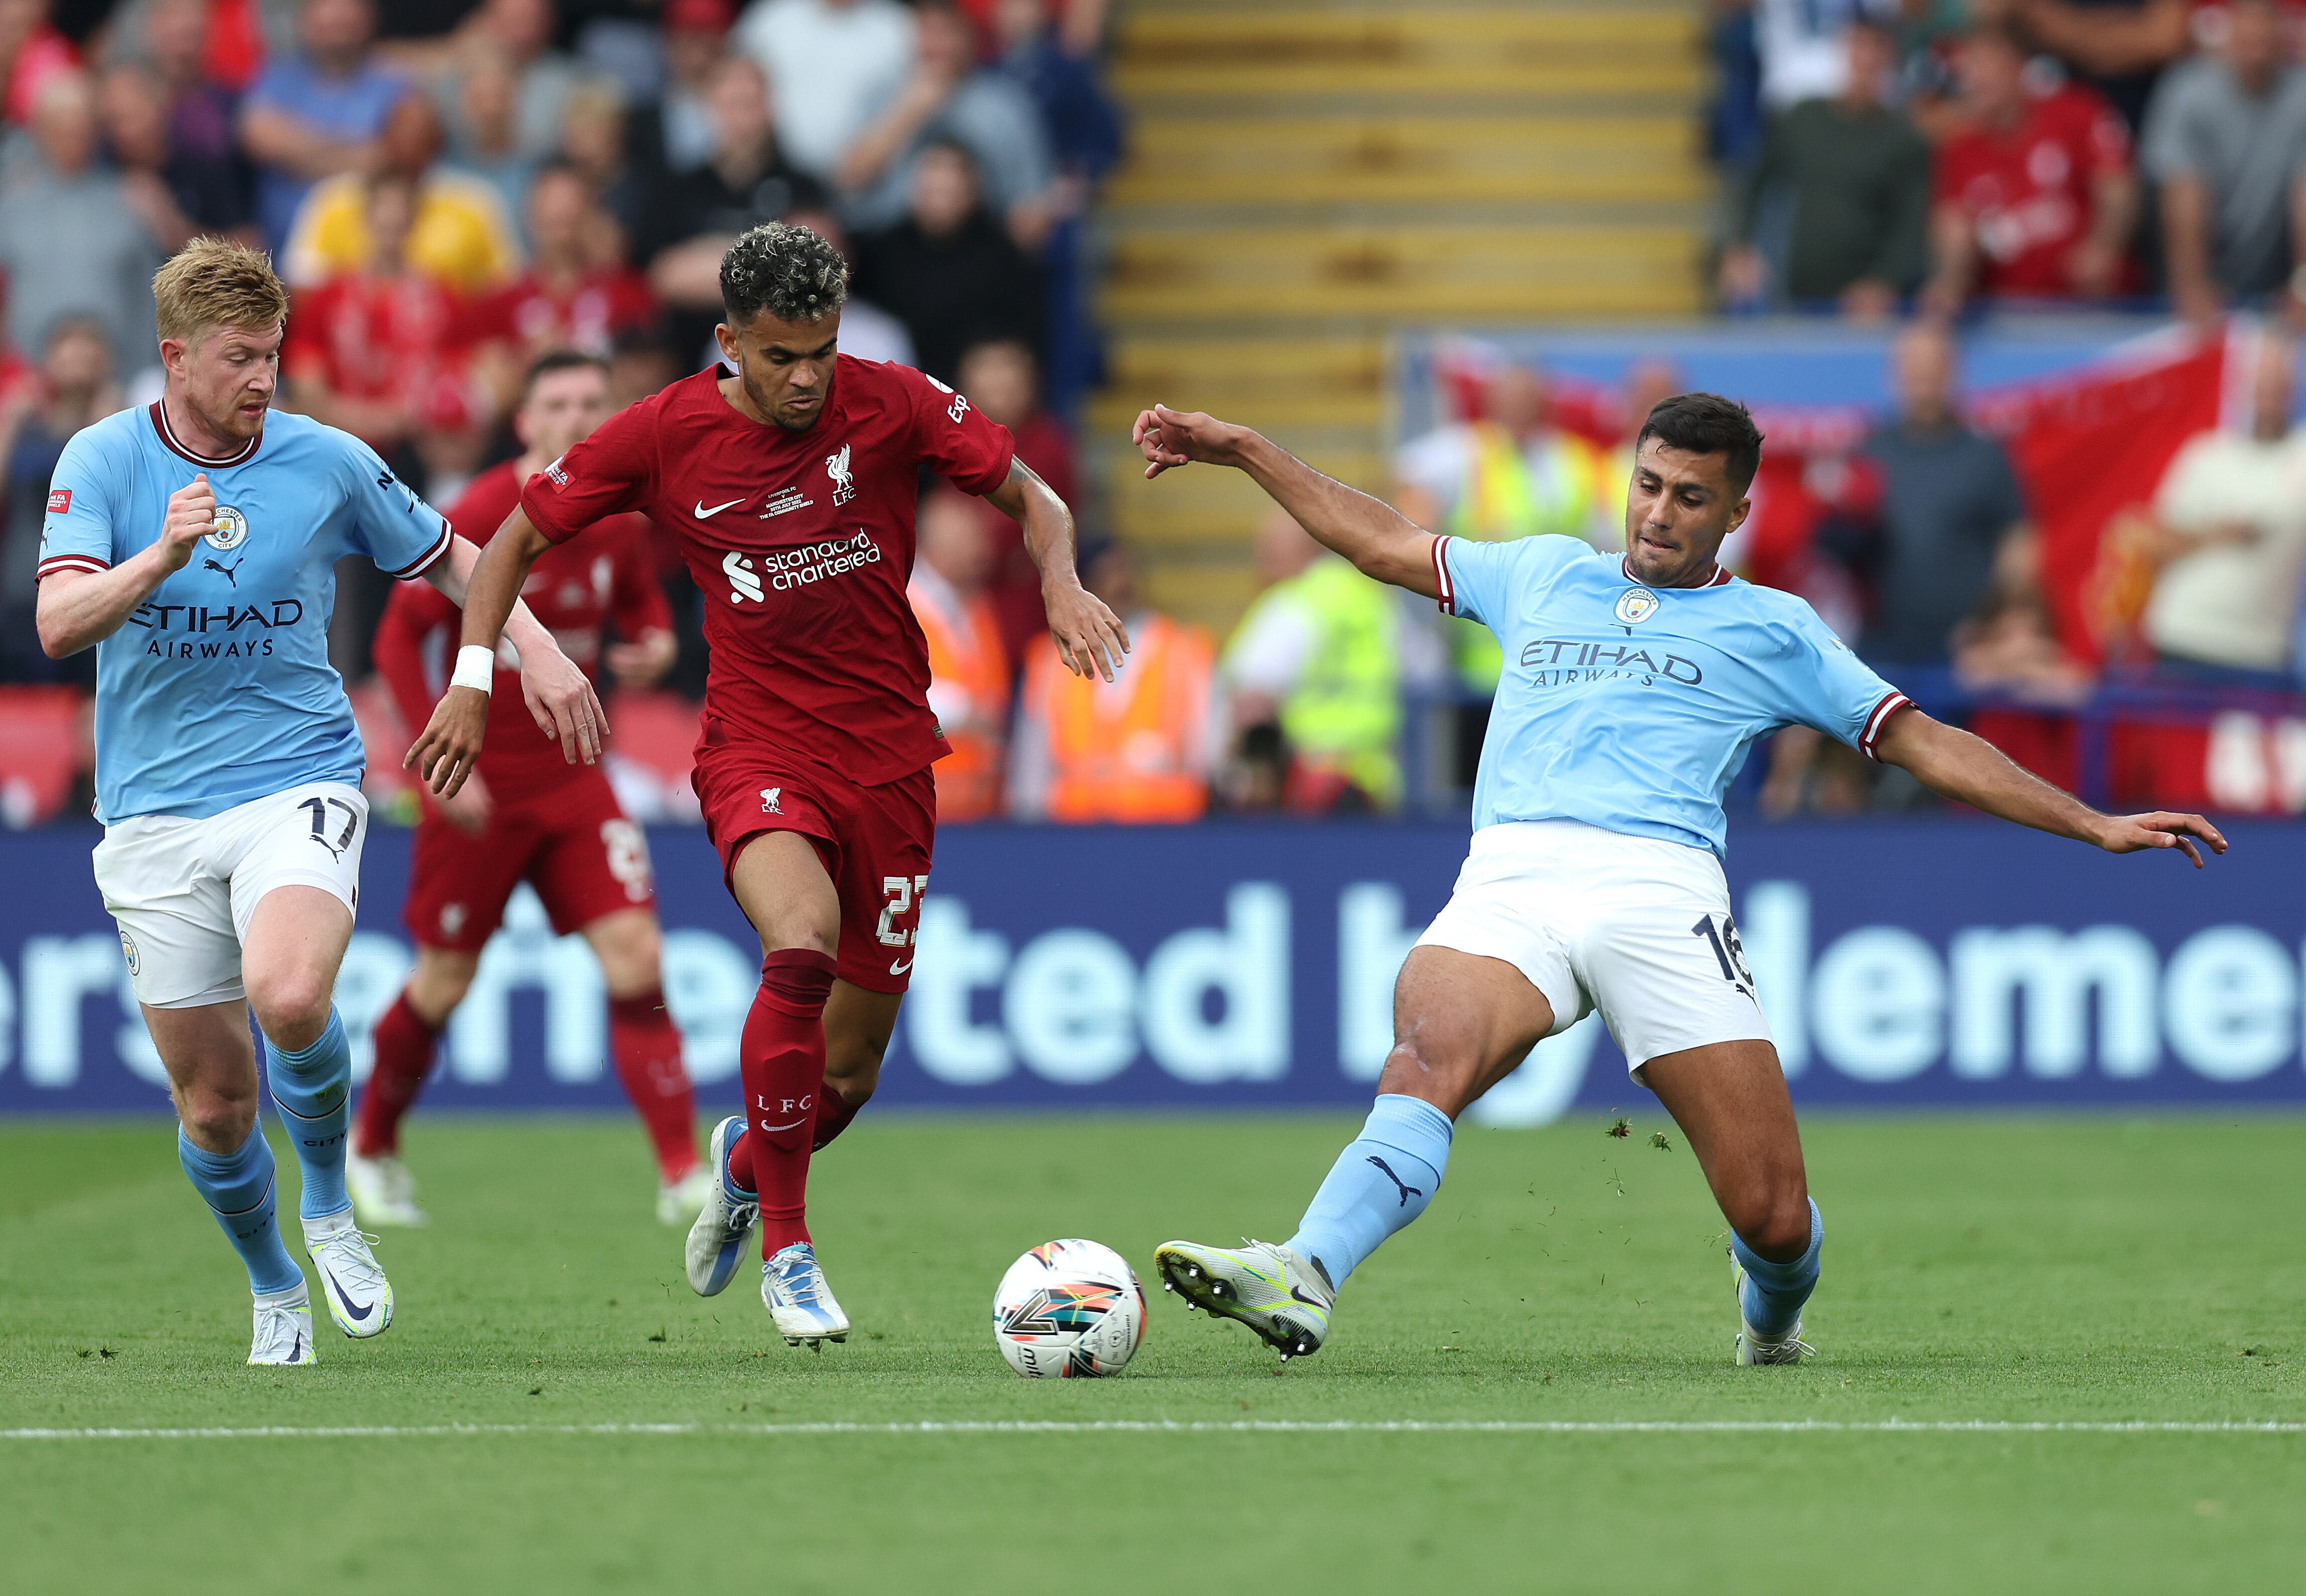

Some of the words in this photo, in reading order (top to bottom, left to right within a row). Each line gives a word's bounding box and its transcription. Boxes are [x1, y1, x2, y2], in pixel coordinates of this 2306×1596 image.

[559, 472, 568, 482] FA
[766, 497, 793, 508] MANCHESTER
[768, 488, 790, 498] LIVERPOOL
[215, 508, 242, 522] CHESTER
[774, 505, 799, 515] COMMUNITY
[765, 527, 871, 573] standard
[772, 543, 881, 590] chartered
[1622, 590, 1657, 606] MANCHESTER
[128, 599, 303, 633] ETIHAD
[147, 639, 274, 659] AIRWAYS
[1521, 640, 1702, 685] ETIHAD
[1533, 669, 1656, 687] AIRWAYS
[297, 796, 358, 851] 17
[303, 1126, 348, 1147] CITY
